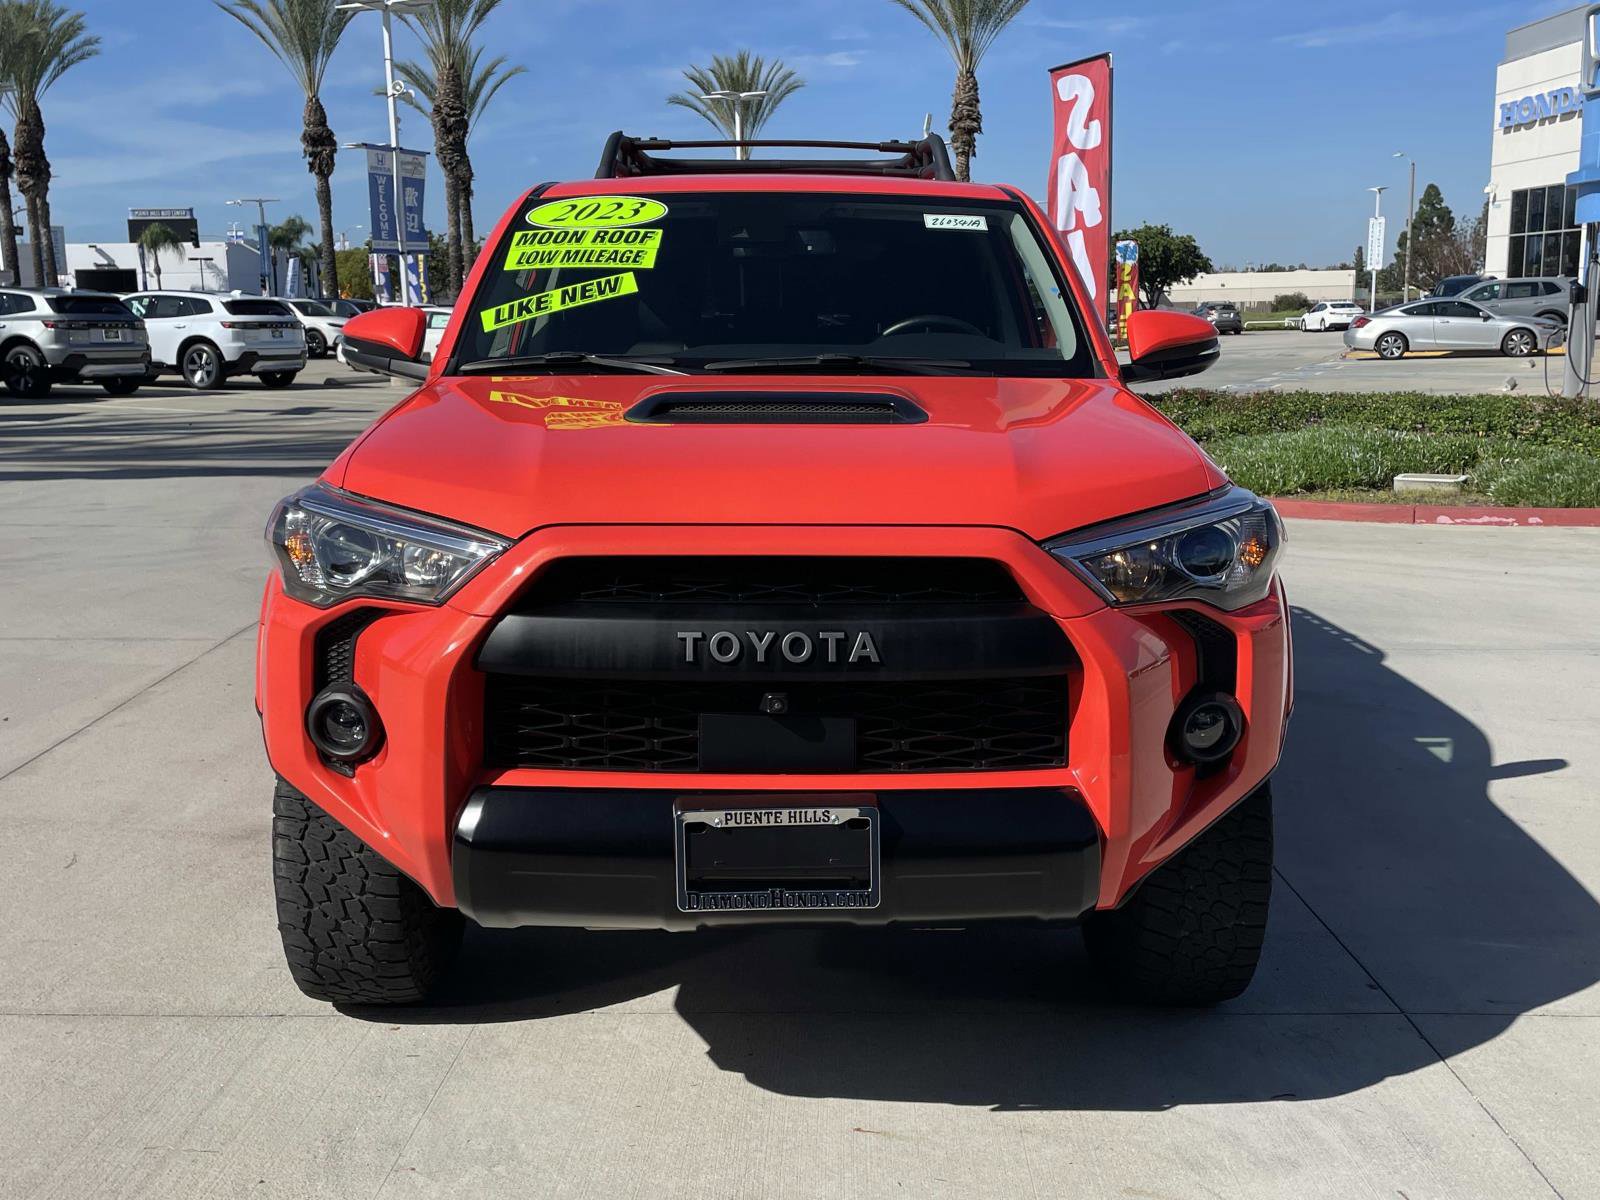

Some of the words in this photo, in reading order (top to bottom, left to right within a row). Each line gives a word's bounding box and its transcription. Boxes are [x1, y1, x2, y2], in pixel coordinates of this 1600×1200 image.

[375, 175, 389, 240] WELCOME
[550, 201, 647, 223] 2023
[515, 230, 587, 247] MOON
[591, 229, 657, 246] ROOF
[516, 249, 561, 266] LOW
[560, 249, 647, 266] MILEAGE
[493, 292, 553, 327] LIKE
[560, 275, 624, 307] NEW
[677, 630, 881, 663] TOYOTA
[723, 810, 784, 826] PUENTE
[787, 809, 831, 825] HILLS
